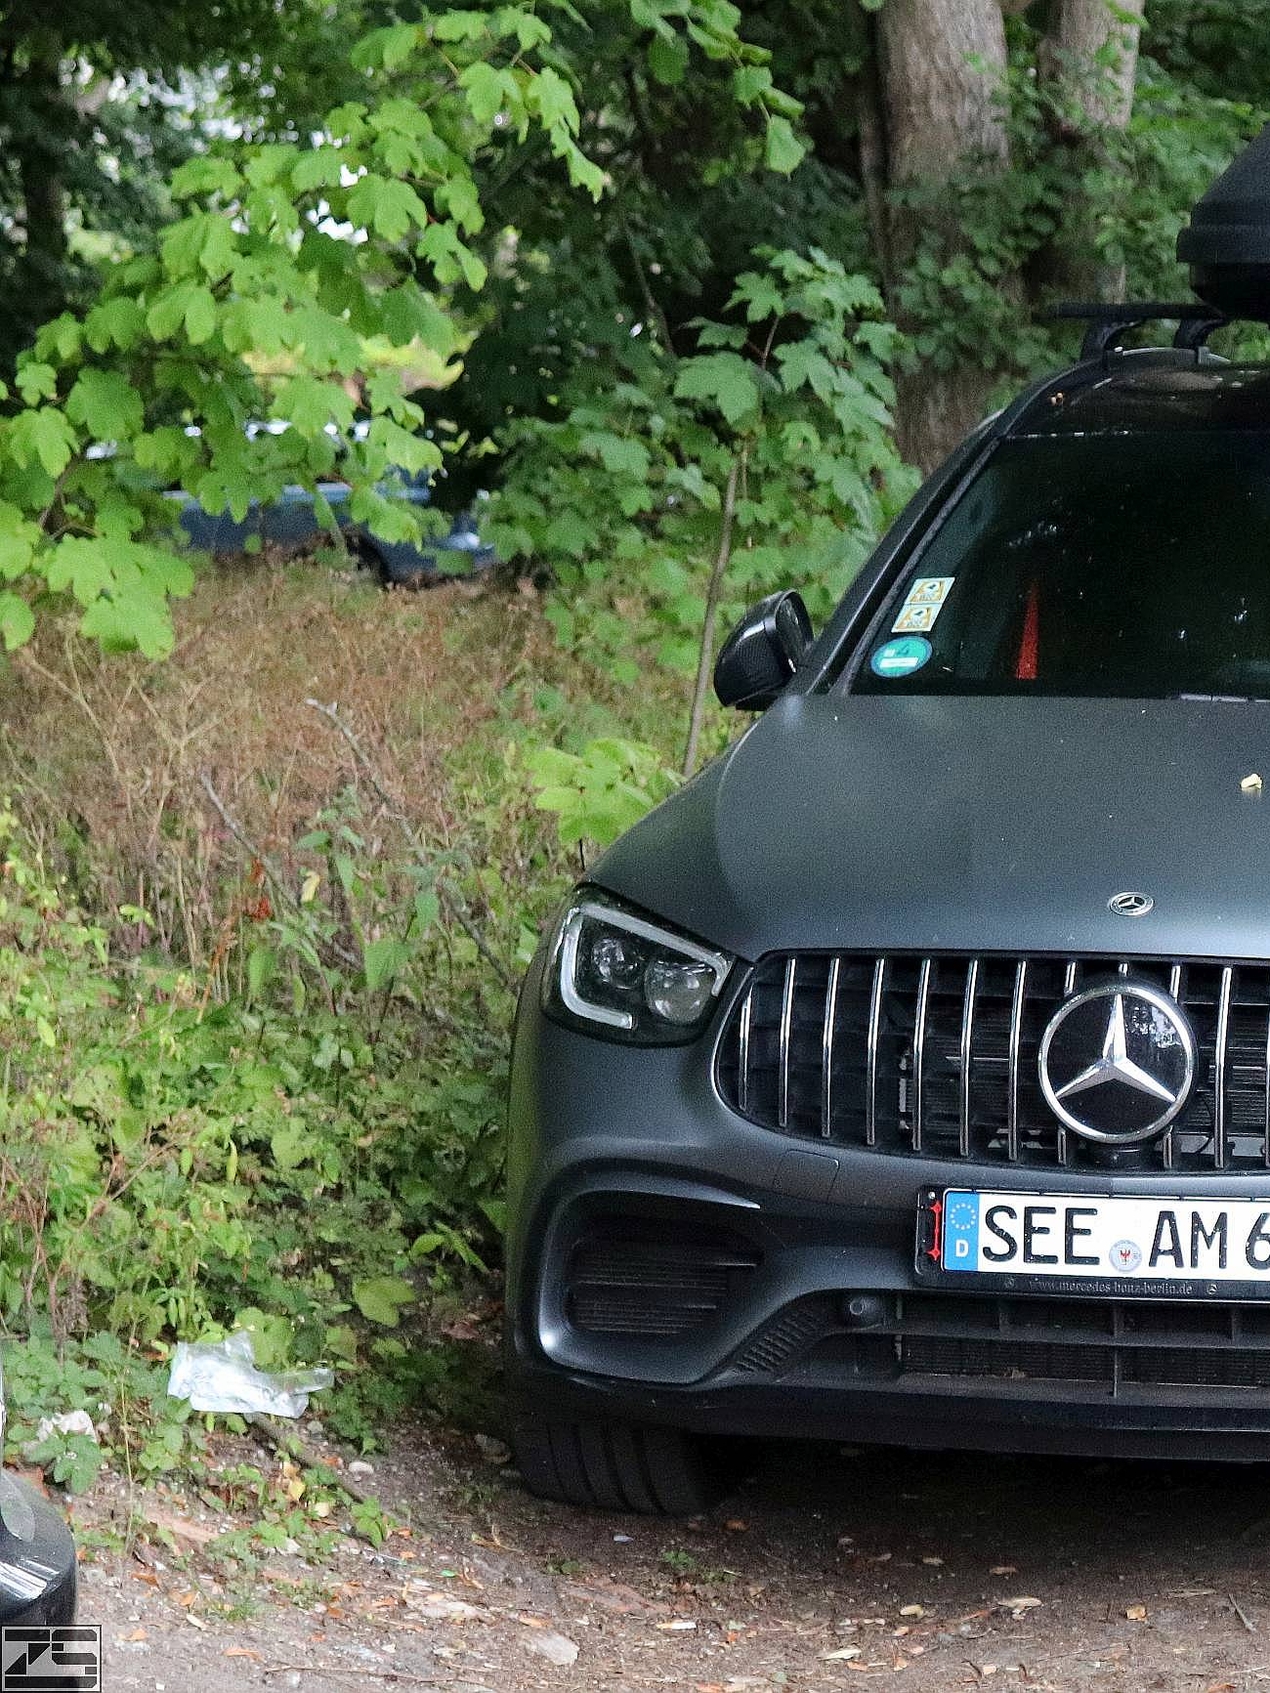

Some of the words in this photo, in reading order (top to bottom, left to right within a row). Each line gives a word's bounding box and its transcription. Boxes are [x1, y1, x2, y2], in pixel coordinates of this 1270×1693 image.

[955, 1239, 968, 1258] D
[983, 1205, 1100, 1264] SEE
[1149, 1210, 1228, 1269] AM
